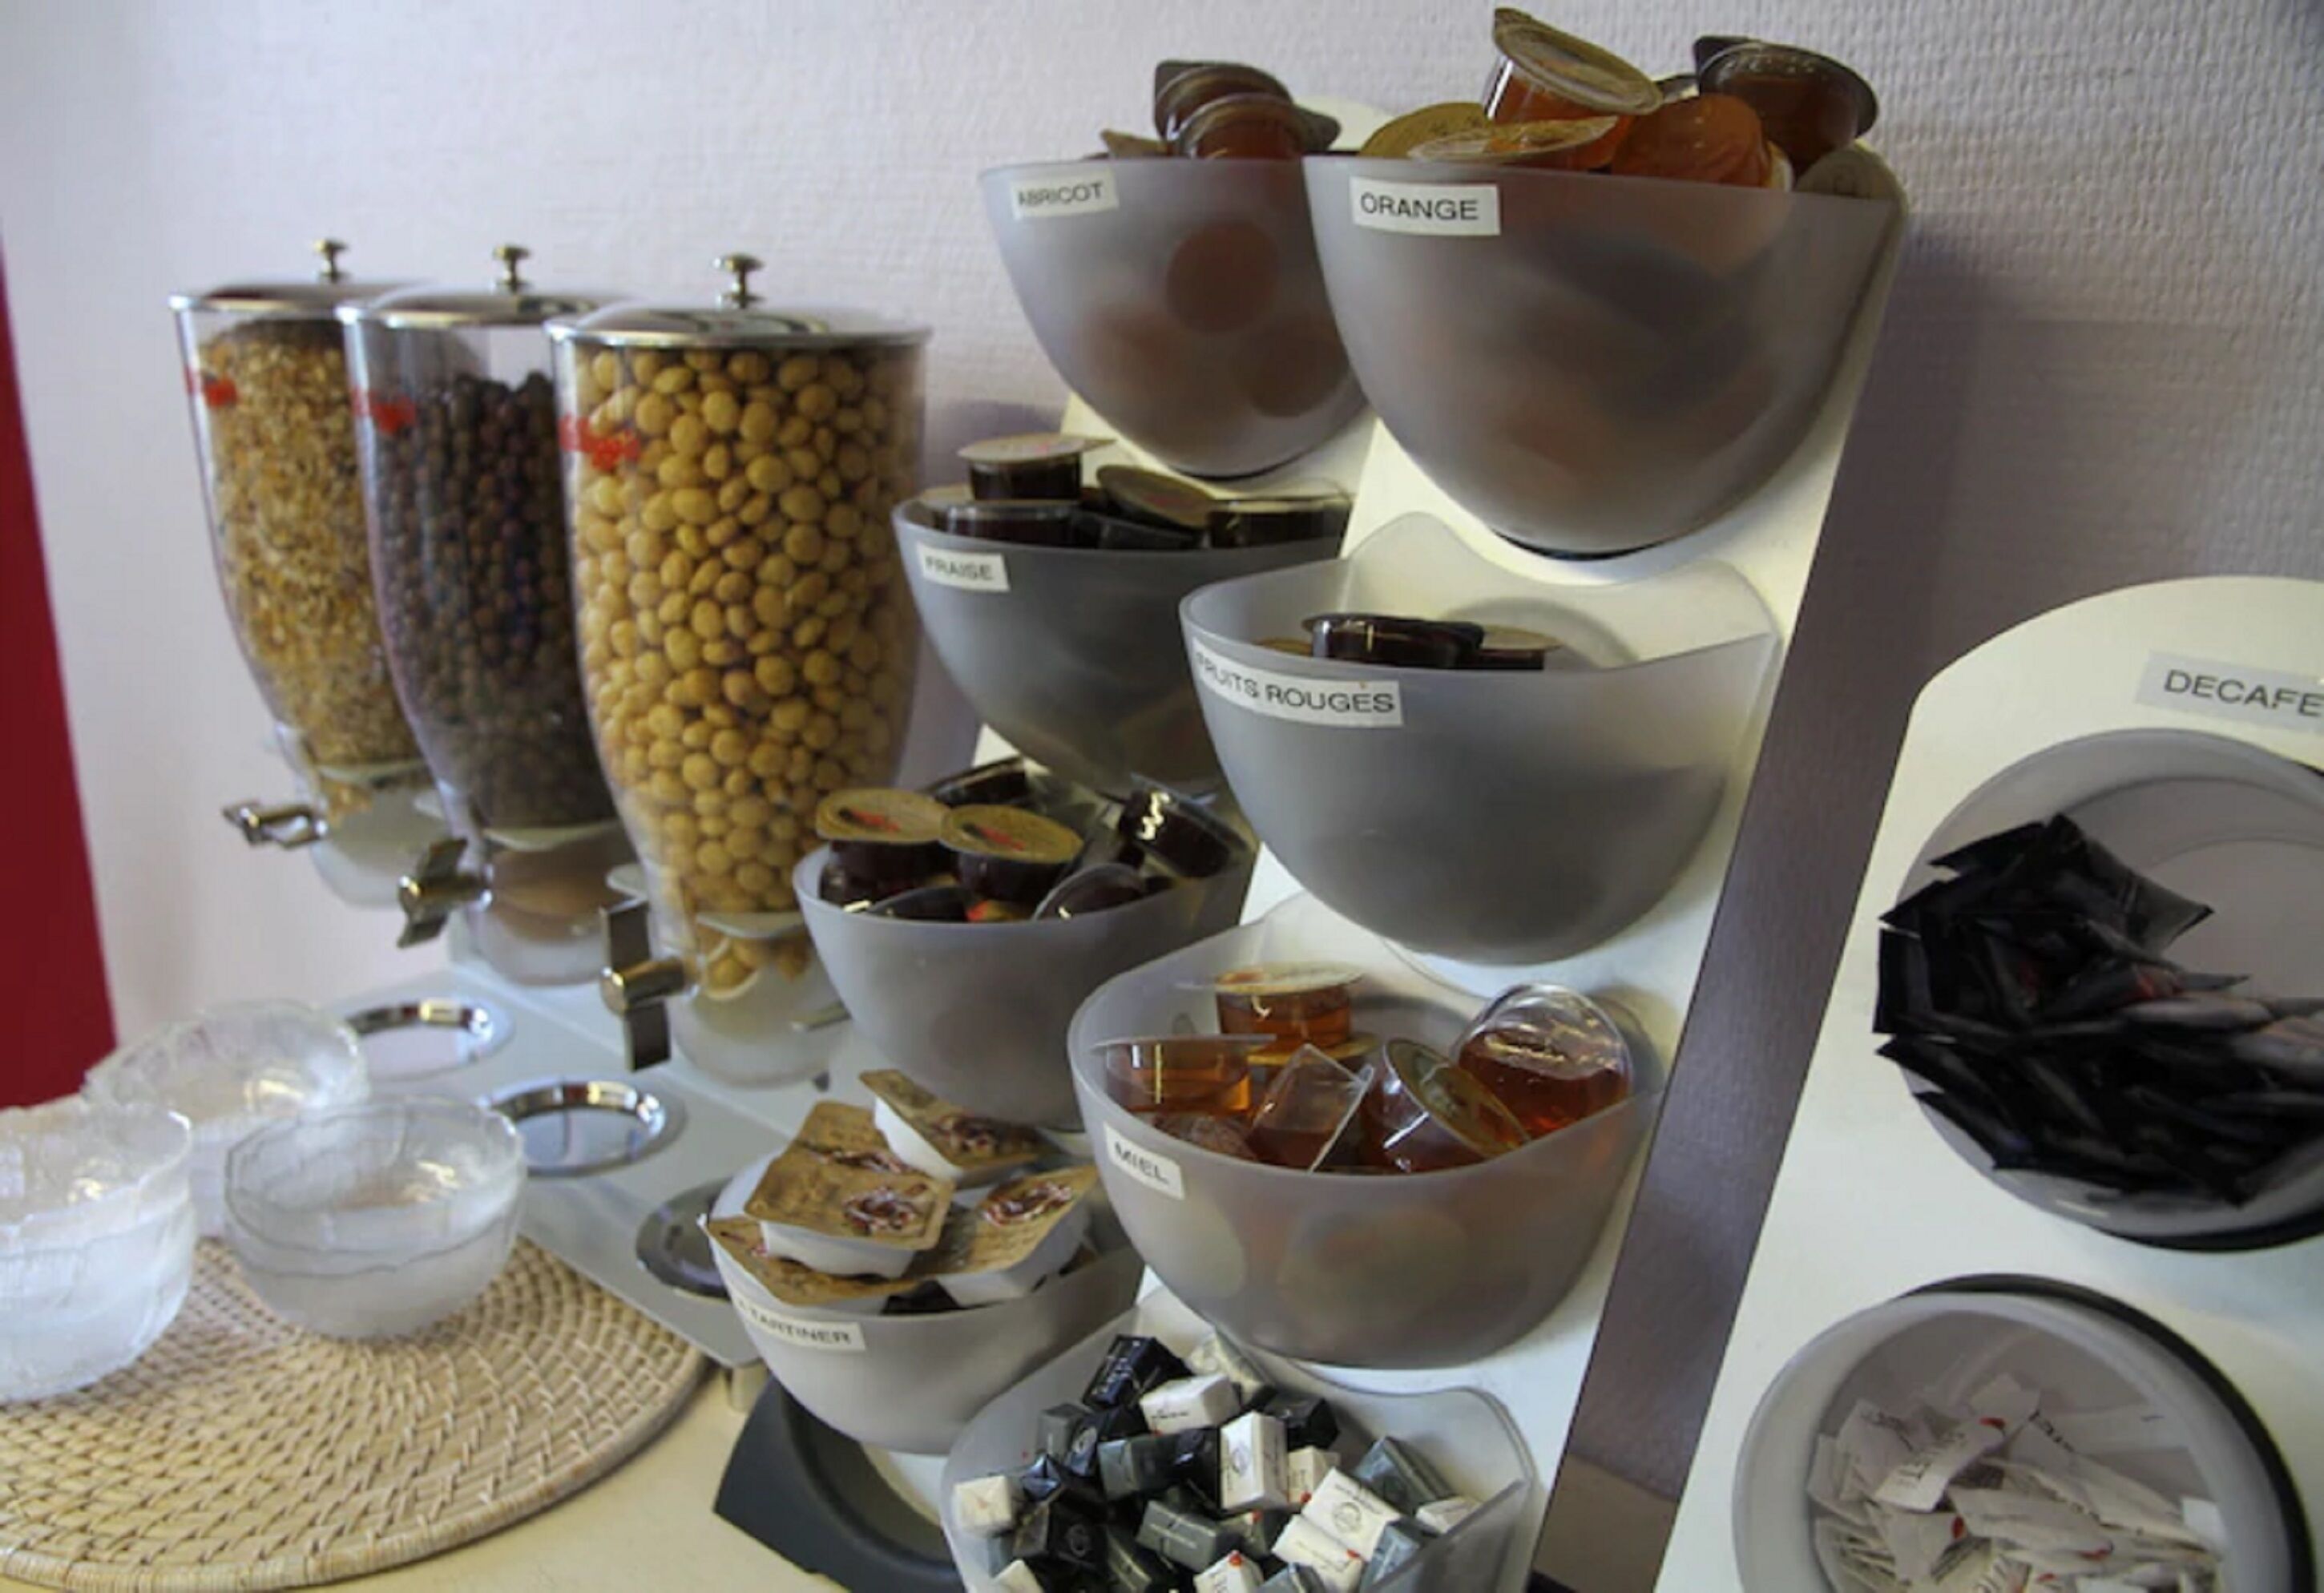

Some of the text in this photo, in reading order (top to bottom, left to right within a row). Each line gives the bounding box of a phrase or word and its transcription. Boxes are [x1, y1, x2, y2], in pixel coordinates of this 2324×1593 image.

[1018, 182, 1103, 206] ABRICOT
[1360, 192, 1479, 220] ORANGE
[925, 556, 994, 581] FRAISE
[1196, 651, 1396, 714] FRUITS ROUGES
[2164, 668, 2324, 717] DECAFE
[1114, 1141, 1170, 1185] MIEL
